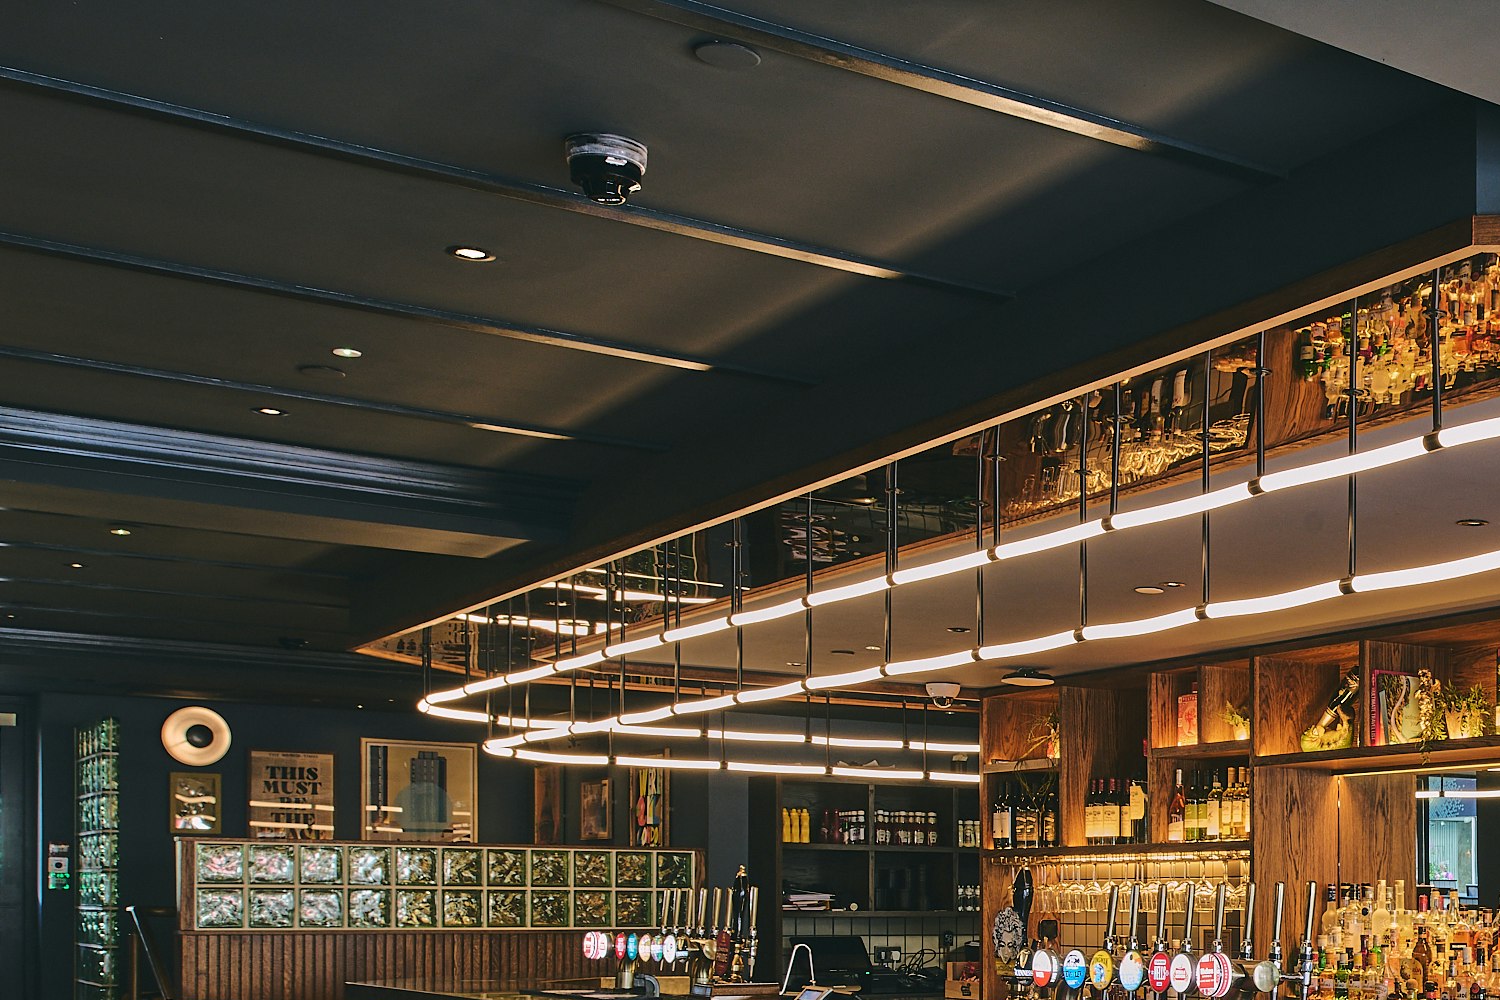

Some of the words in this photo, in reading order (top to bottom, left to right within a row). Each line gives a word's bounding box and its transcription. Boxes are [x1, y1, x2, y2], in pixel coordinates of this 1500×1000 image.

[265, 766, 319, 780] THIS
[262, 781, 322, 795] MUST
[271, 812, 316, 827] THE
